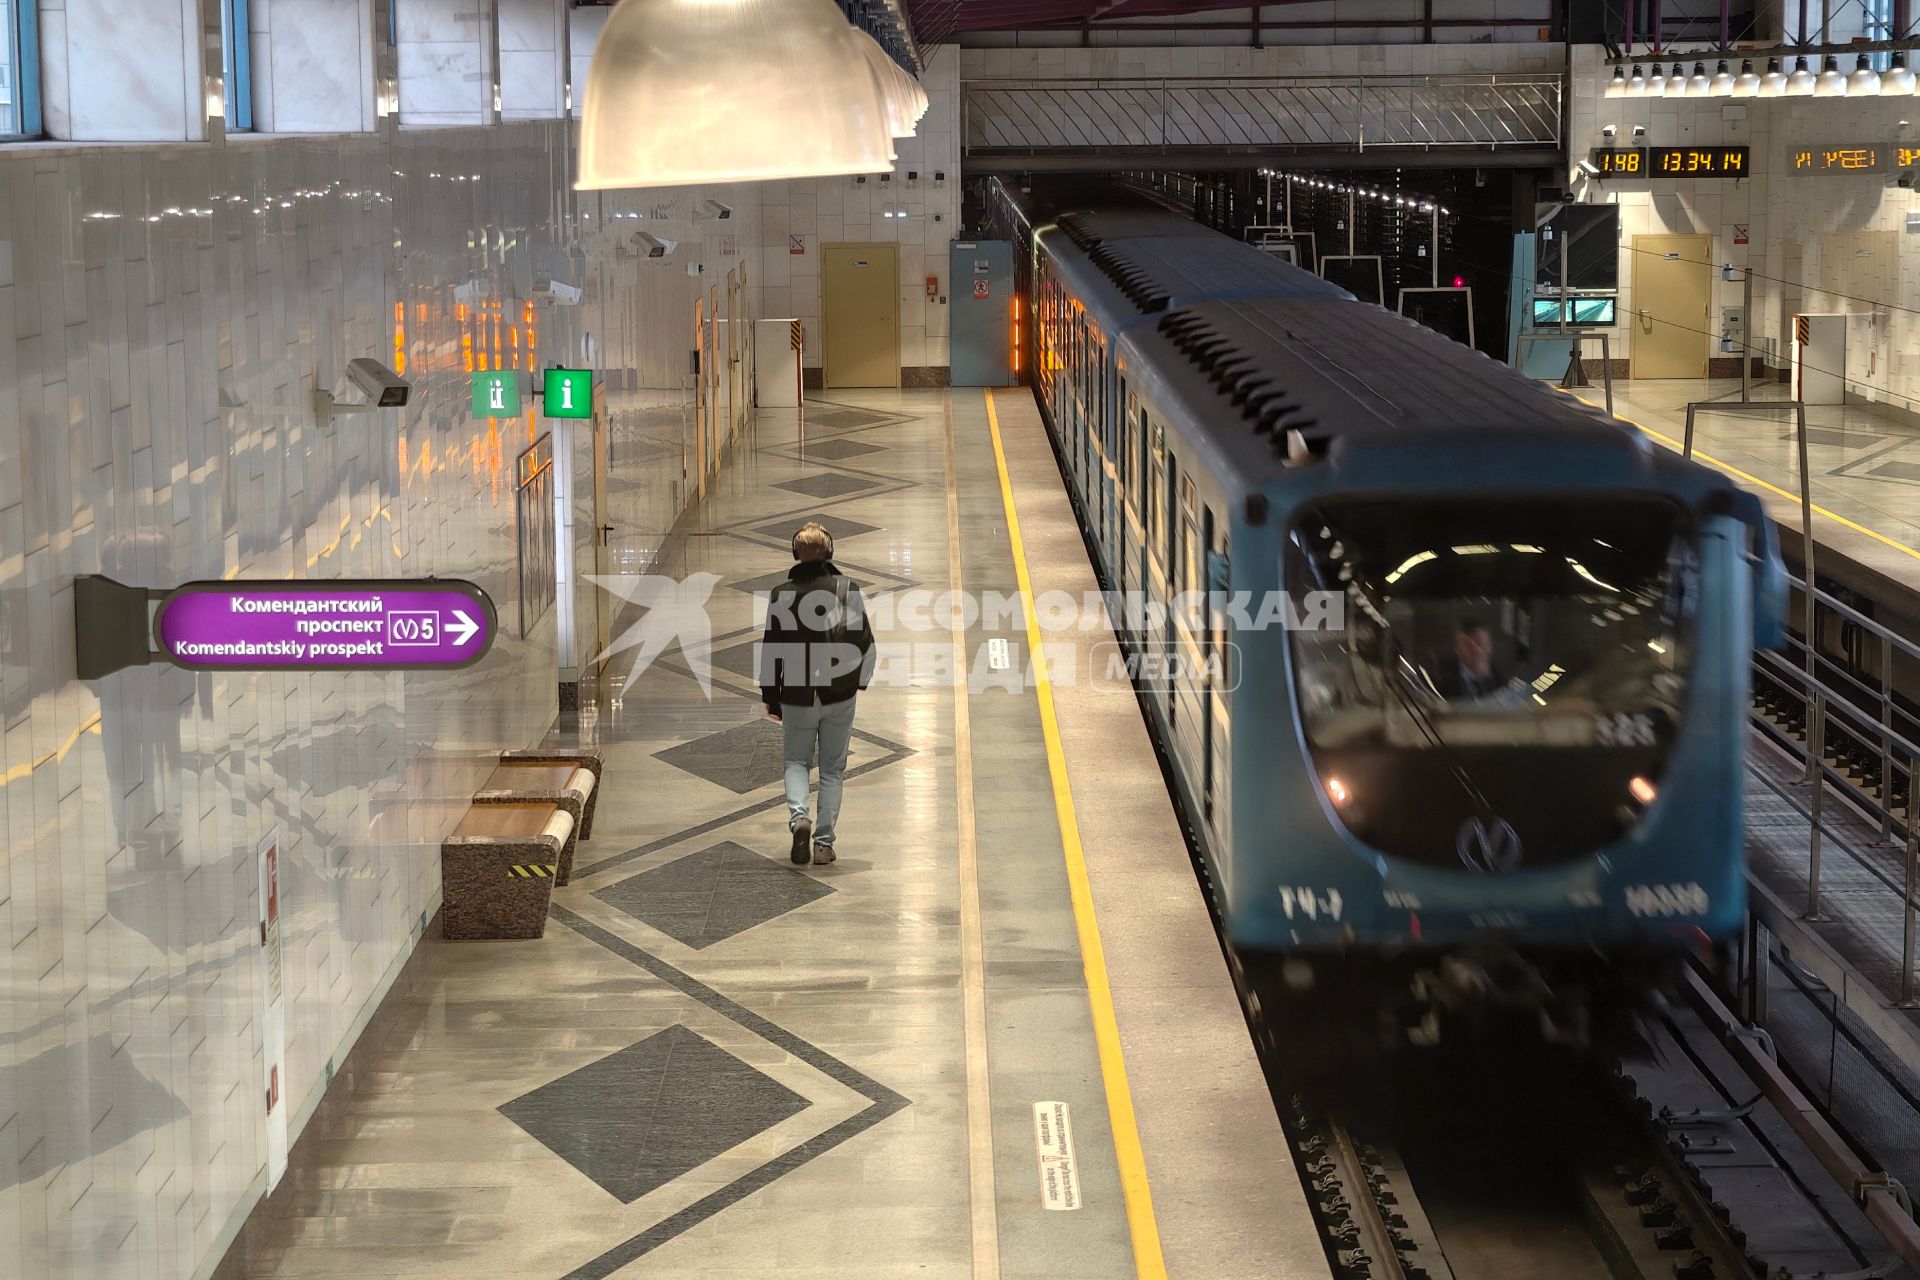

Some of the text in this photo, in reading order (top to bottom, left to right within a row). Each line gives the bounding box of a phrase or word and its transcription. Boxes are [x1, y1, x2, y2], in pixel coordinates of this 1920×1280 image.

[231, 596, 383, 615] Комендантский
[296, 619, 384, 634] проспект
[421, 617, 434, 640] 5
[176, 640, 384, 658] Komendantskiy prospekt
